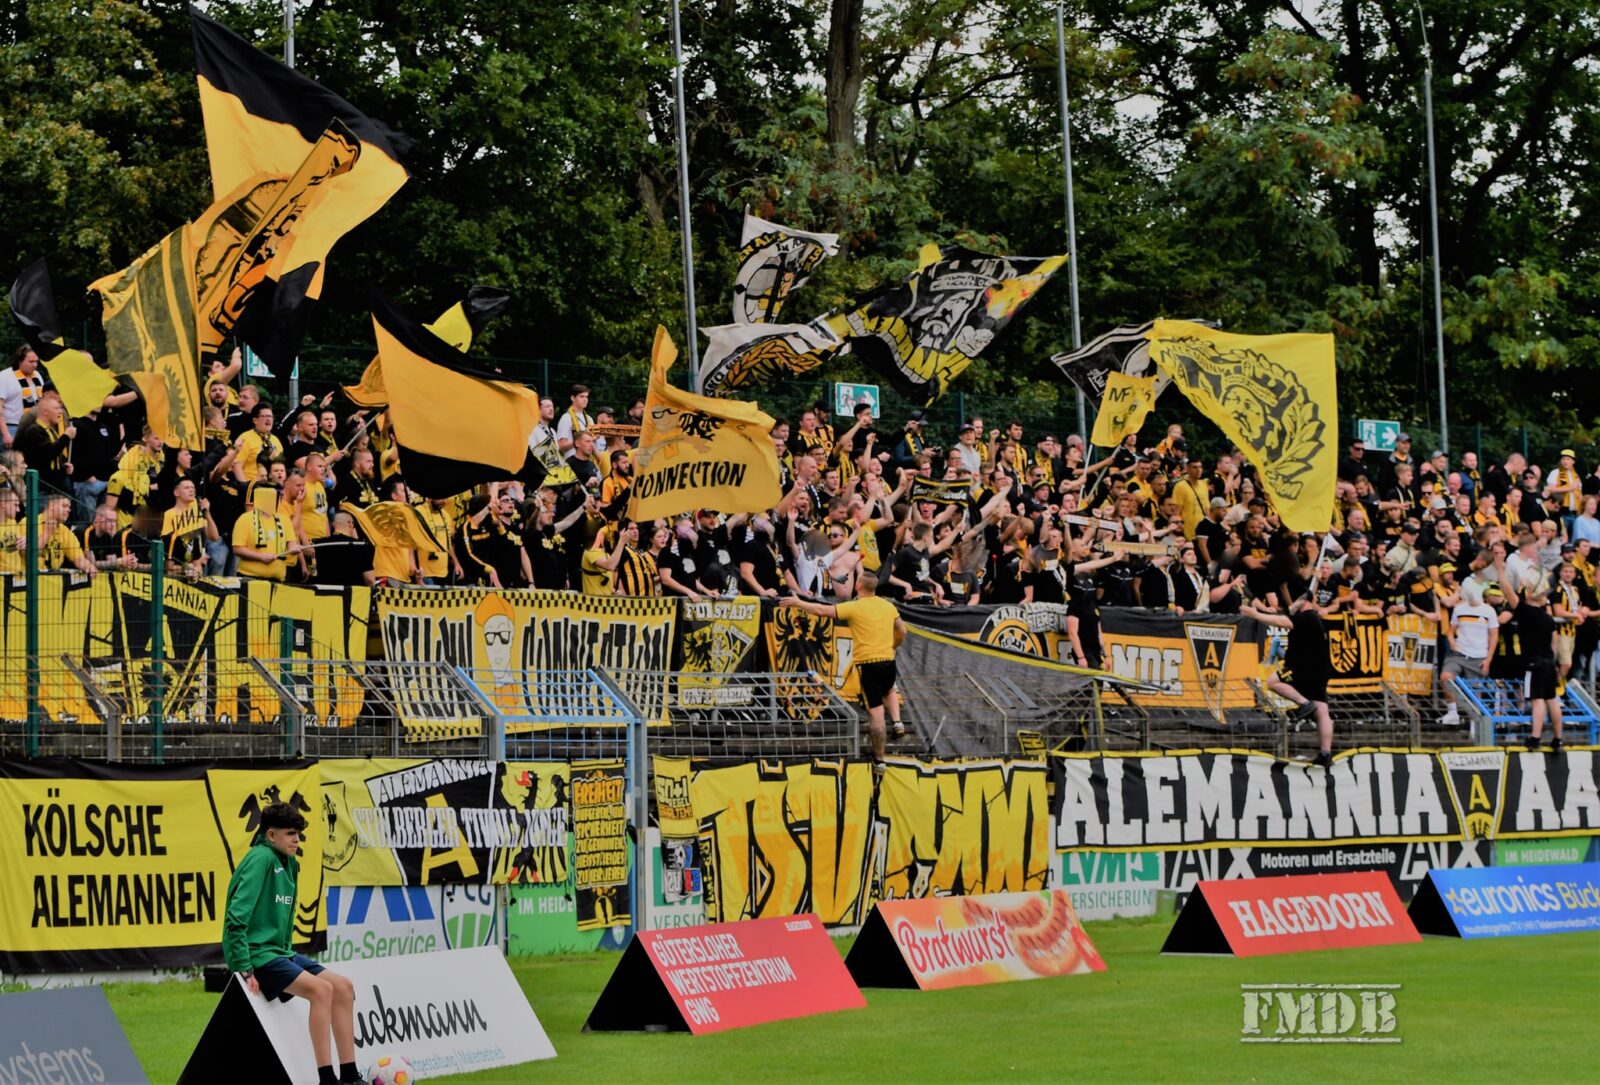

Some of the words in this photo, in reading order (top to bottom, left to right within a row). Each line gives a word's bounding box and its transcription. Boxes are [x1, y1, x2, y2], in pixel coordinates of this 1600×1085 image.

[632, 461, 747, 499] CONNECTION
[121, 574, 208, 613] ALEANNIA
[1204, 641, 1220, 667] A
[1057, 753, 1448, 845] ALEMANNIA
[1469, 773, 1491, 810] A
[23, 788, 167, 857] KÖLSCHE
[352, 806, 461, 848] STOLBERGER
[460, 806, 519, 848] TIVOLI
[1261, 852, 1308, 868] Motoren
[1311, 851, 1333, 866] und
[1335, 848, 1396, 865] Ersatzteile
[1504, 850, 1519, 864] IM
[1521, 847, 1579, 863] HEIDEWALD
[32, 871, 216, 928] ALEMANNEN
[518, 896, 535, 916] IM
[538, 895, 576, 914] HEIDE
[1069, 888, 1152, 910] ERSICHERUN
[1229, 891, 1394, 938] HAGEDORN
[1460, 875, 1561, 916] euronics
[651, 931, 745, 967] GÜTERSLOHER
[898, 911, 1014, 973] Bratwurst
[665, 956, 797, 996] WERTSTOFFZENTRUM
[354, 985, 488, 1048] uckmann
[684, 995, 721, 1026] GWG
